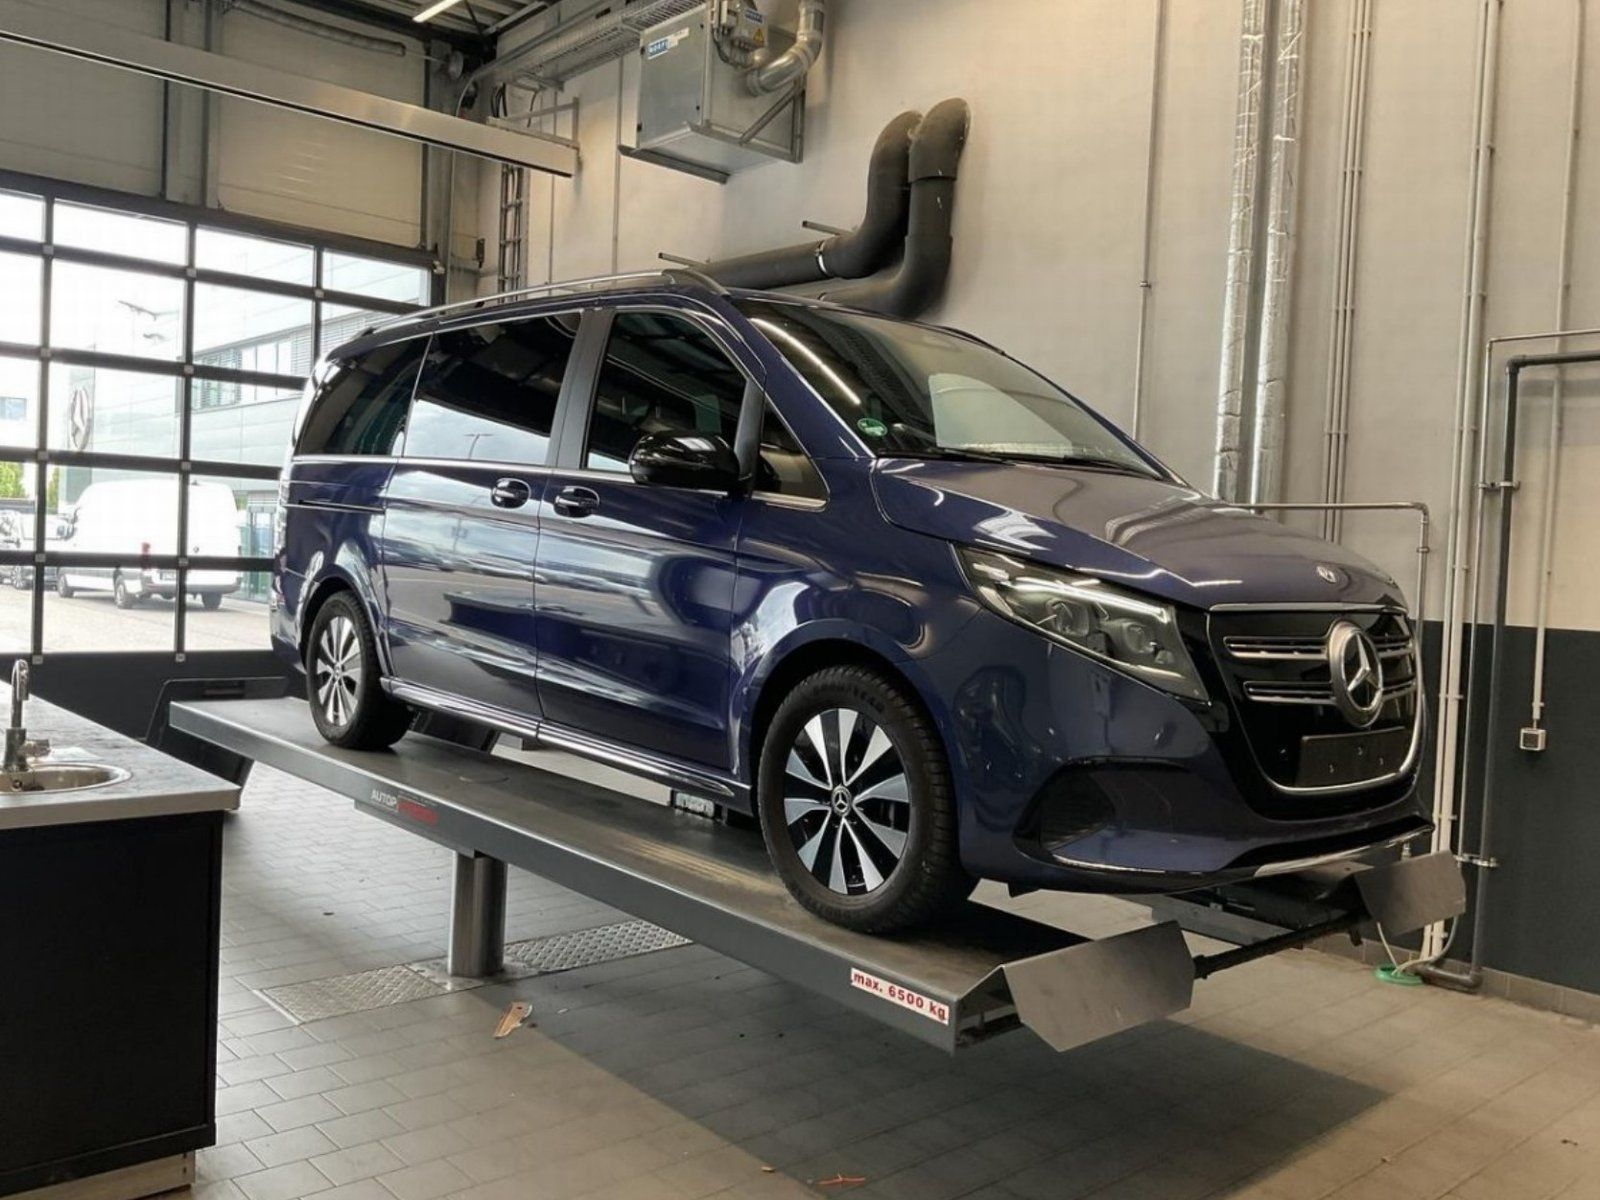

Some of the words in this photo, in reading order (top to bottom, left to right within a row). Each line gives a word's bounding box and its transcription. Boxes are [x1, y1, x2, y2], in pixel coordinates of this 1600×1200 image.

[853, 972, 883, 993] max.
[888, 985, 924, 1009] 6500
[929, 1000, 946, 1020] kg
